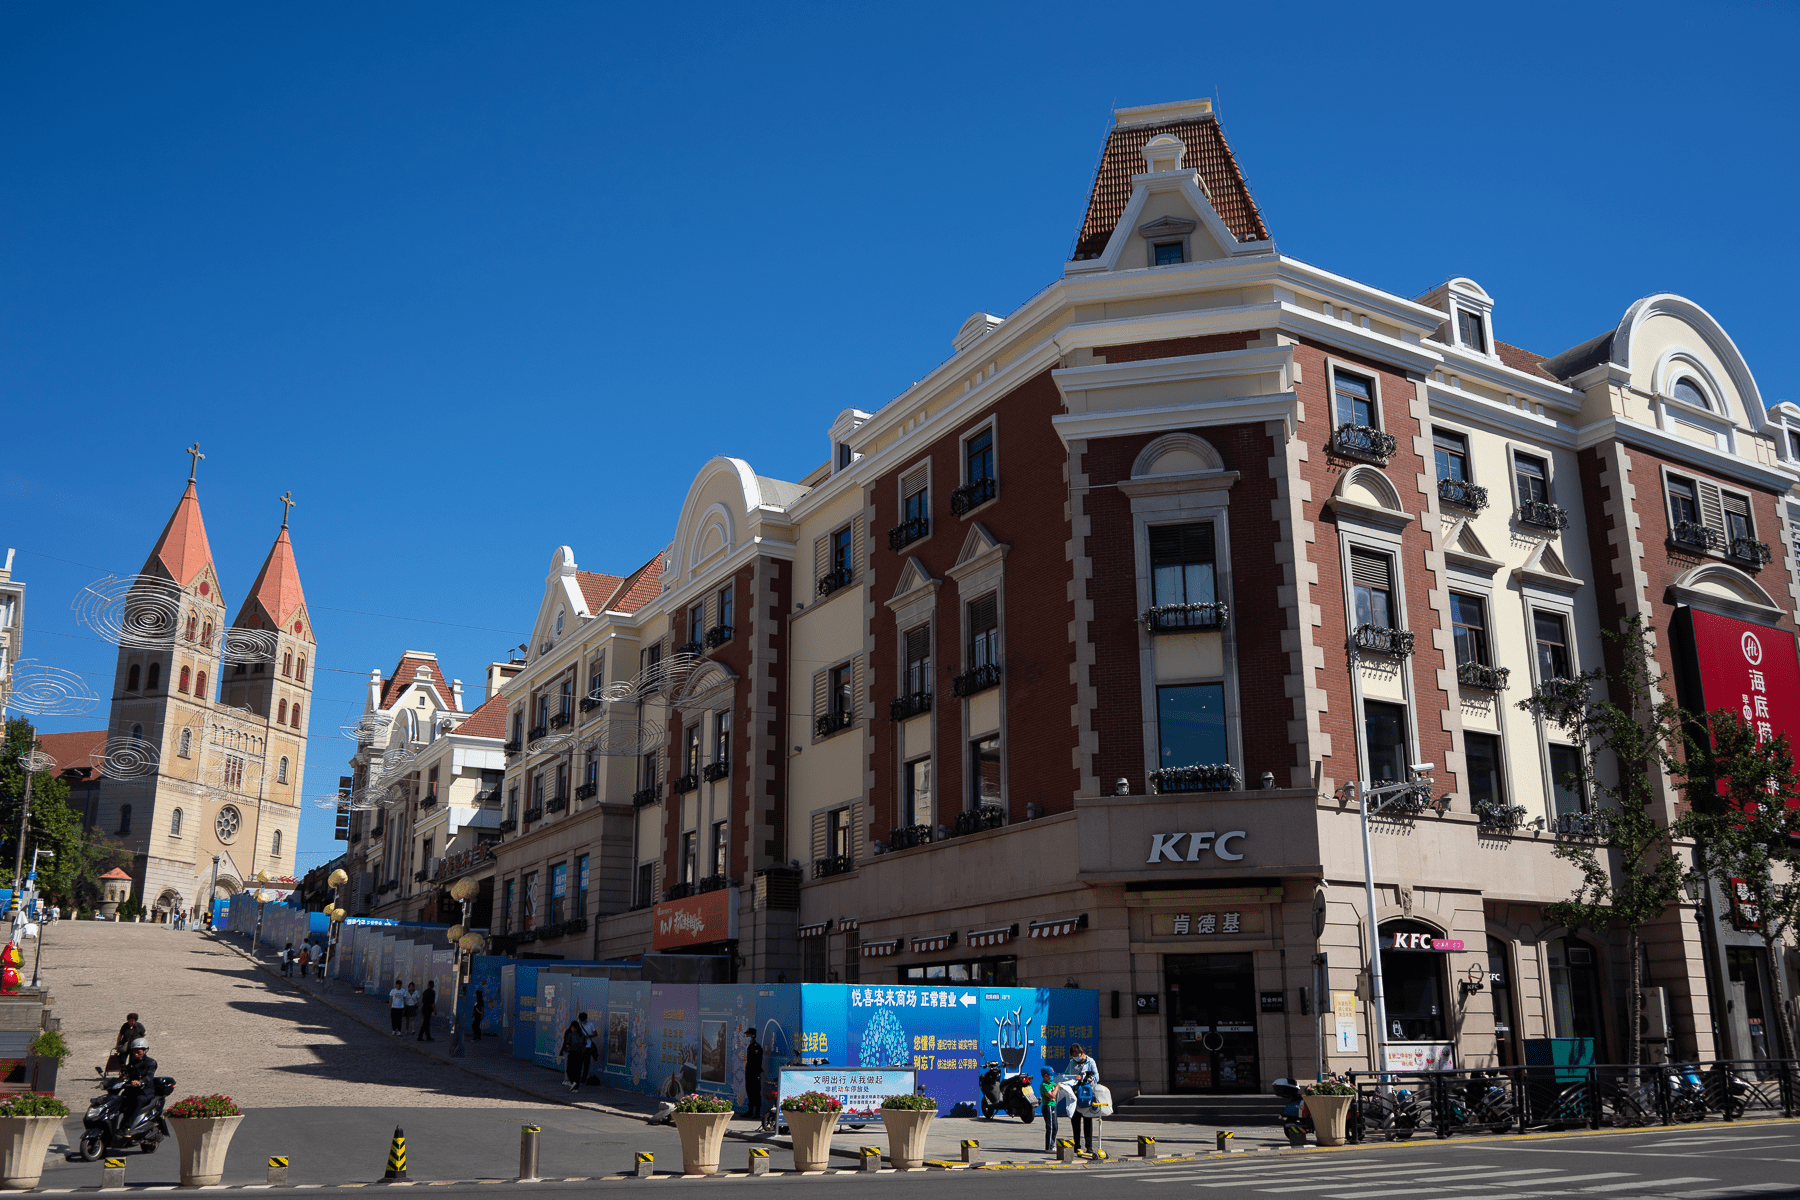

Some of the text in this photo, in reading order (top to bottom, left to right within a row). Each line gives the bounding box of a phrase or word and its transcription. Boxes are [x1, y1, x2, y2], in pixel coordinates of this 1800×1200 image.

[1146, 830, 1246, 864] KFC
[1173, 912, 1240, 935] 肯德基
[1394, 932, 1431, 949] KFC
[851, 988, 957, 1008] 悦喜客来商场 正常营业
[913, 1035, 936, 1051] 您懂得
[913, 1055, 936, 1071] 别忘了
[813, 1075, 883, 1085] 文明出行 从我做起
[825, 1085, 870, 1093] 非机动车停放处
